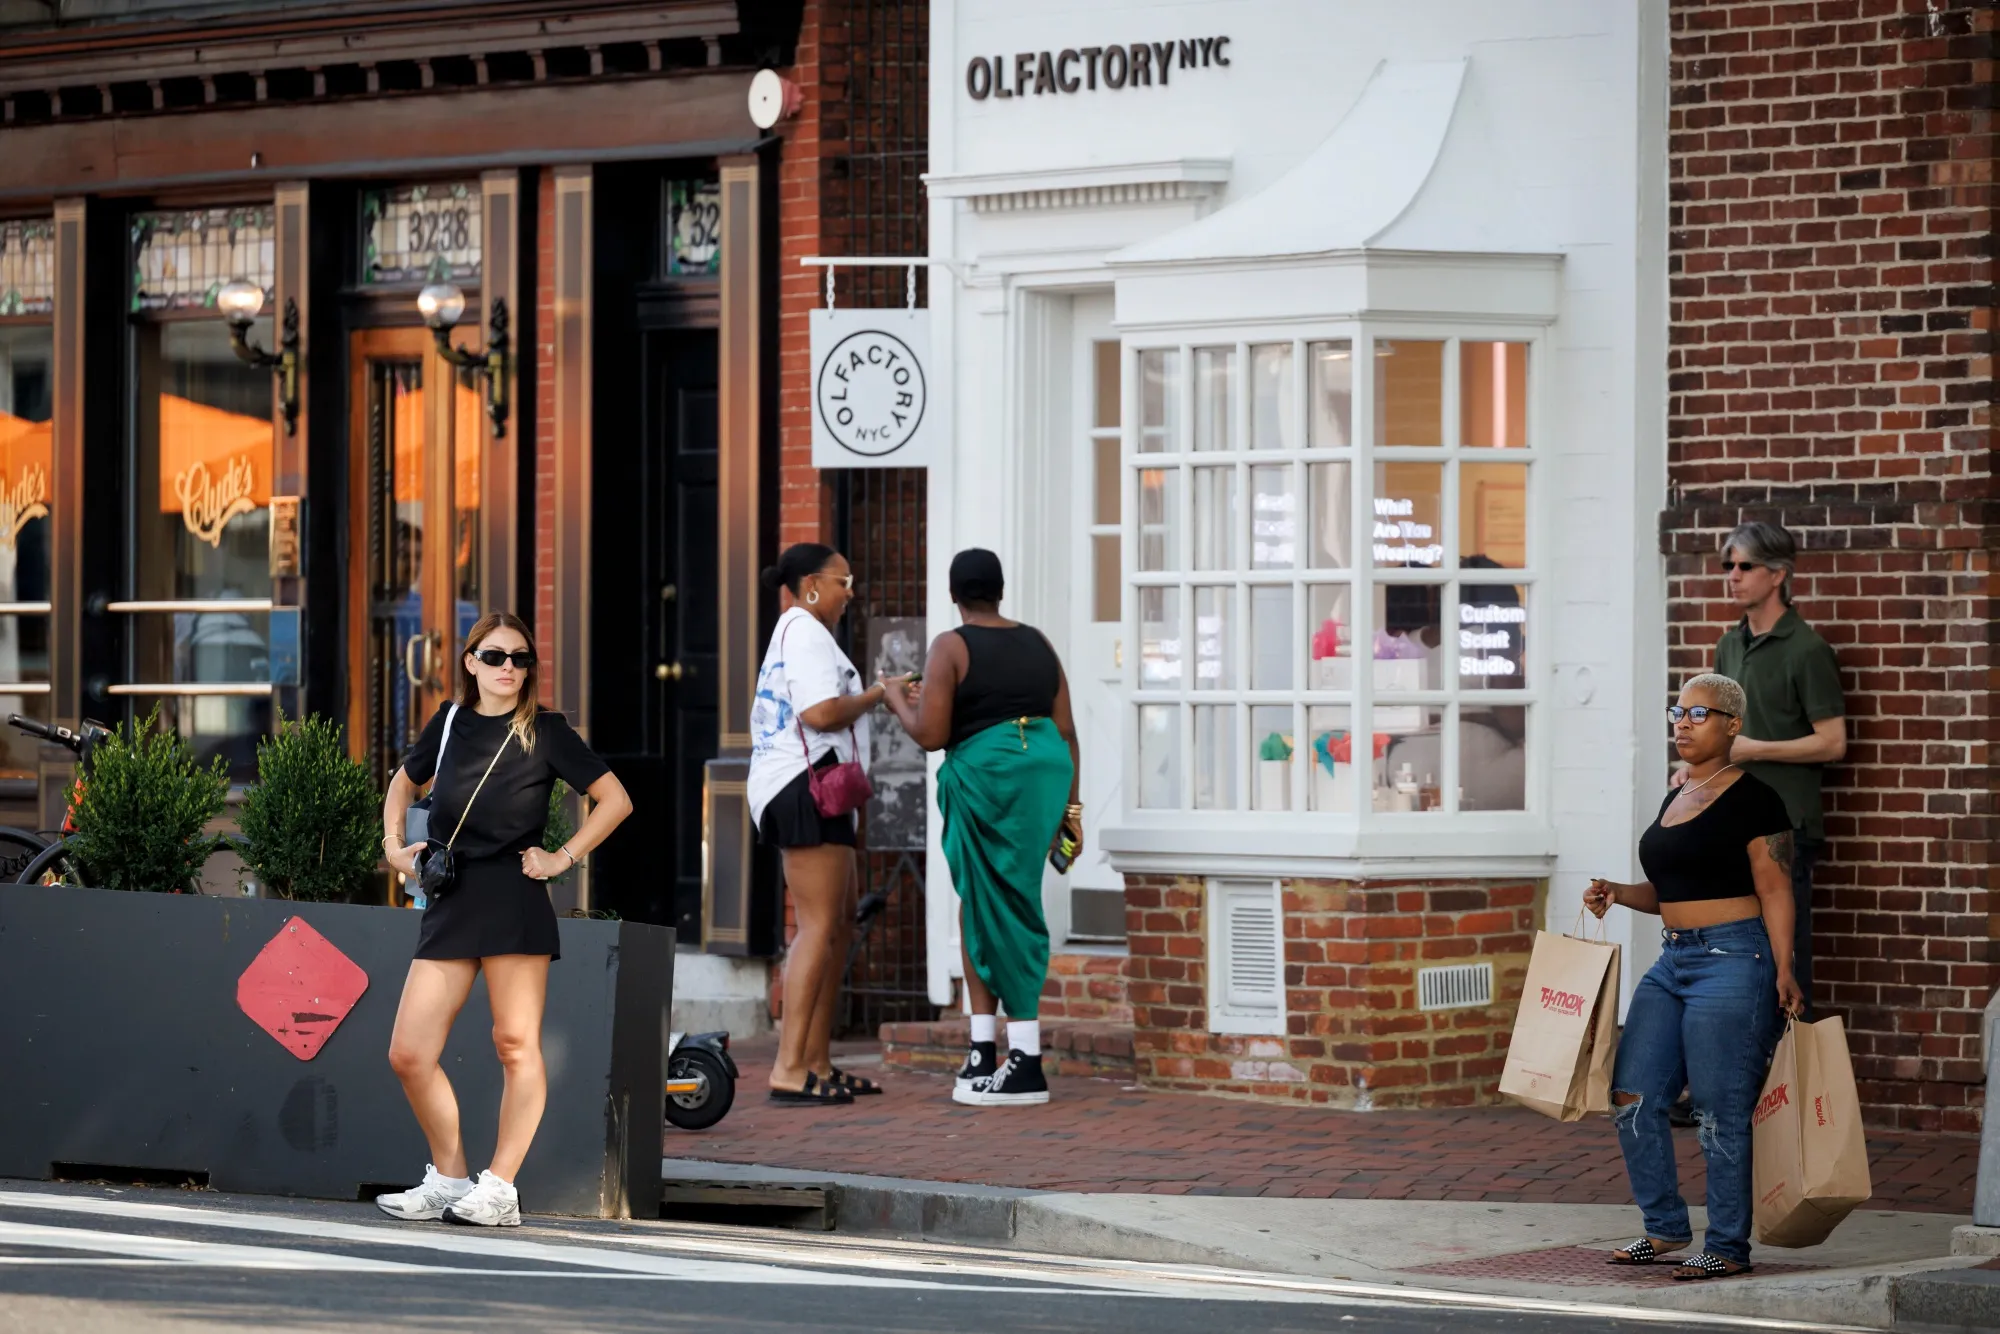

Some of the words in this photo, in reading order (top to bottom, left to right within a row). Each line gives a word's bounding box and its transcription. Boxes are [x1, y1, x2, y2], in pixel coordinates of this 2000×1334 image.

[967, 42, 1175, 100] OLFACTORY
[1179, 36, 1231, 69] NYC
[409, 208, 469, 253] 3238
[830, 345, 913, 428] OLFACTORY
[855, 424, 891, 441] NYC
[175, 454, 257, 549] Clyde's
[1373, 498, 1413, 516] What
[1373, 521, 1401, 539] Are
[1398, 520, 1432, 539] You
[1373, 543, 1444, 565] Wearing?
[1460, 603, 1526, 624] Custom
[1459, 629, 1511, 650] Scent
[1459, 655, 1516, 677] Studio
